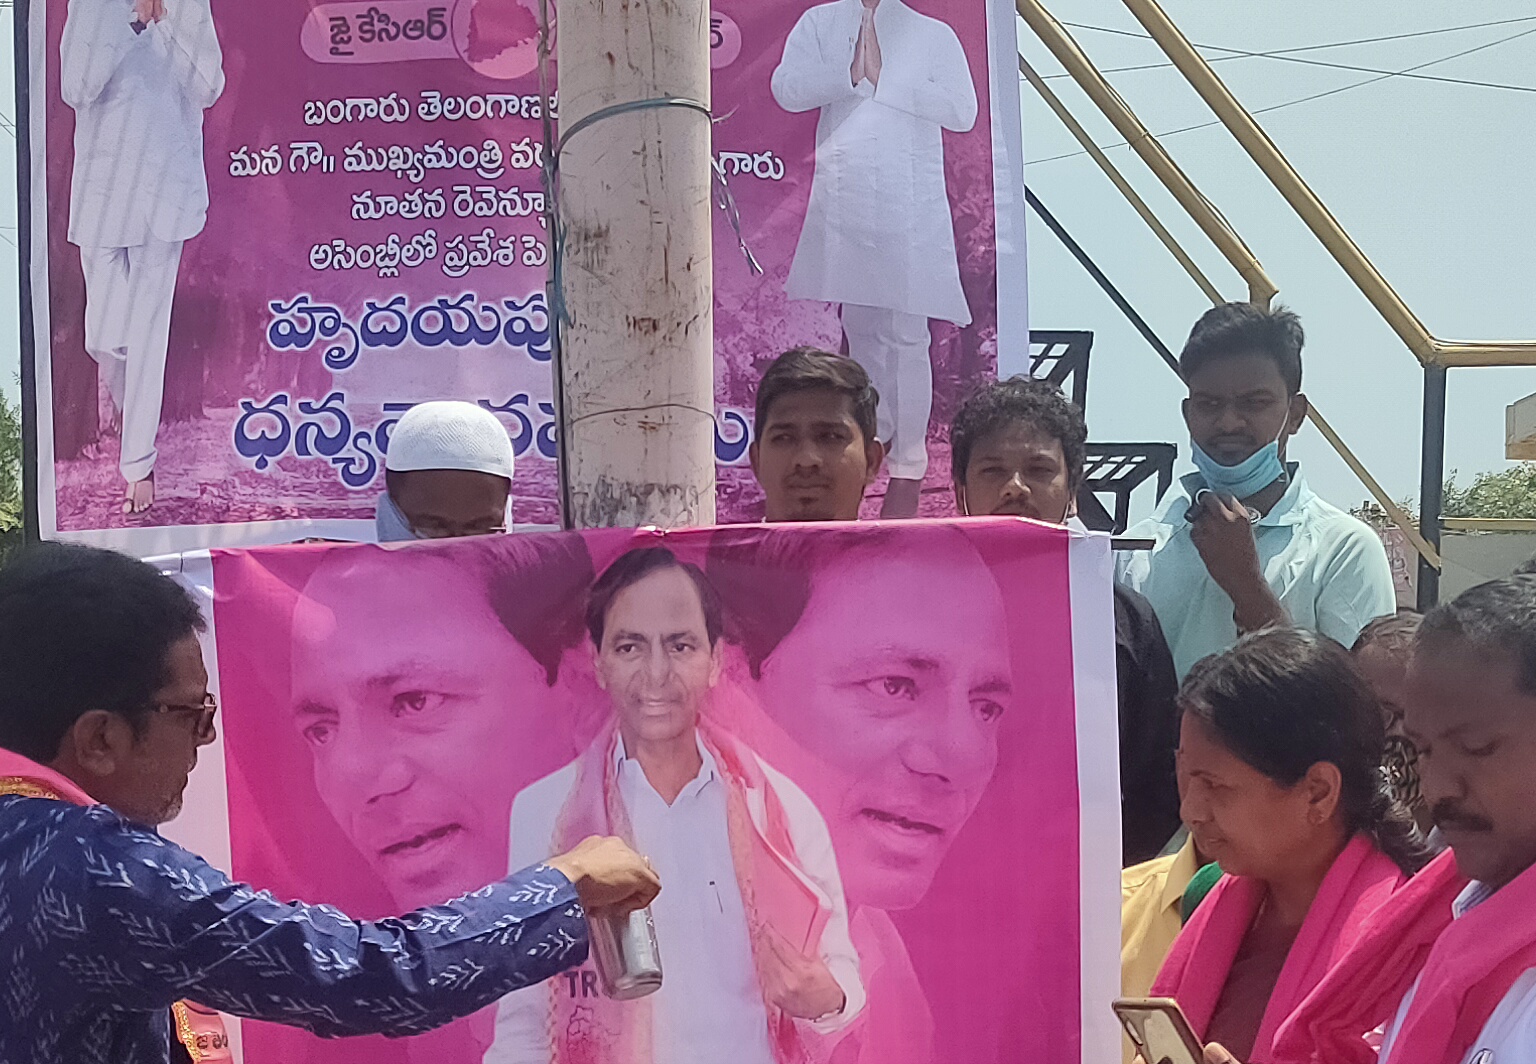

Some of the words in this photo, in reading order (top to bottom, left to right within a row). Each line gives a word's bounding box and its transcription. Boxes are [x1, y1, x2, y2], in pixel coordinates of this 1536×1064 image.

[329, 16, 354, 55] జై
[358, 8, 447, 43] కేసిఆర్
[303, 93, 409, 125] బంగారు
[229, 145, 283, 176] మన
[343, 139, 505, 183] ముఖ్యమంత్రి
[351, 188, 446, 219] నూతన
[310, 229, 437, 277] అసెంబ్లీలో
[442, 228, 516, 276] ప్రవేశ
[564, 971, 599, 998] TR
